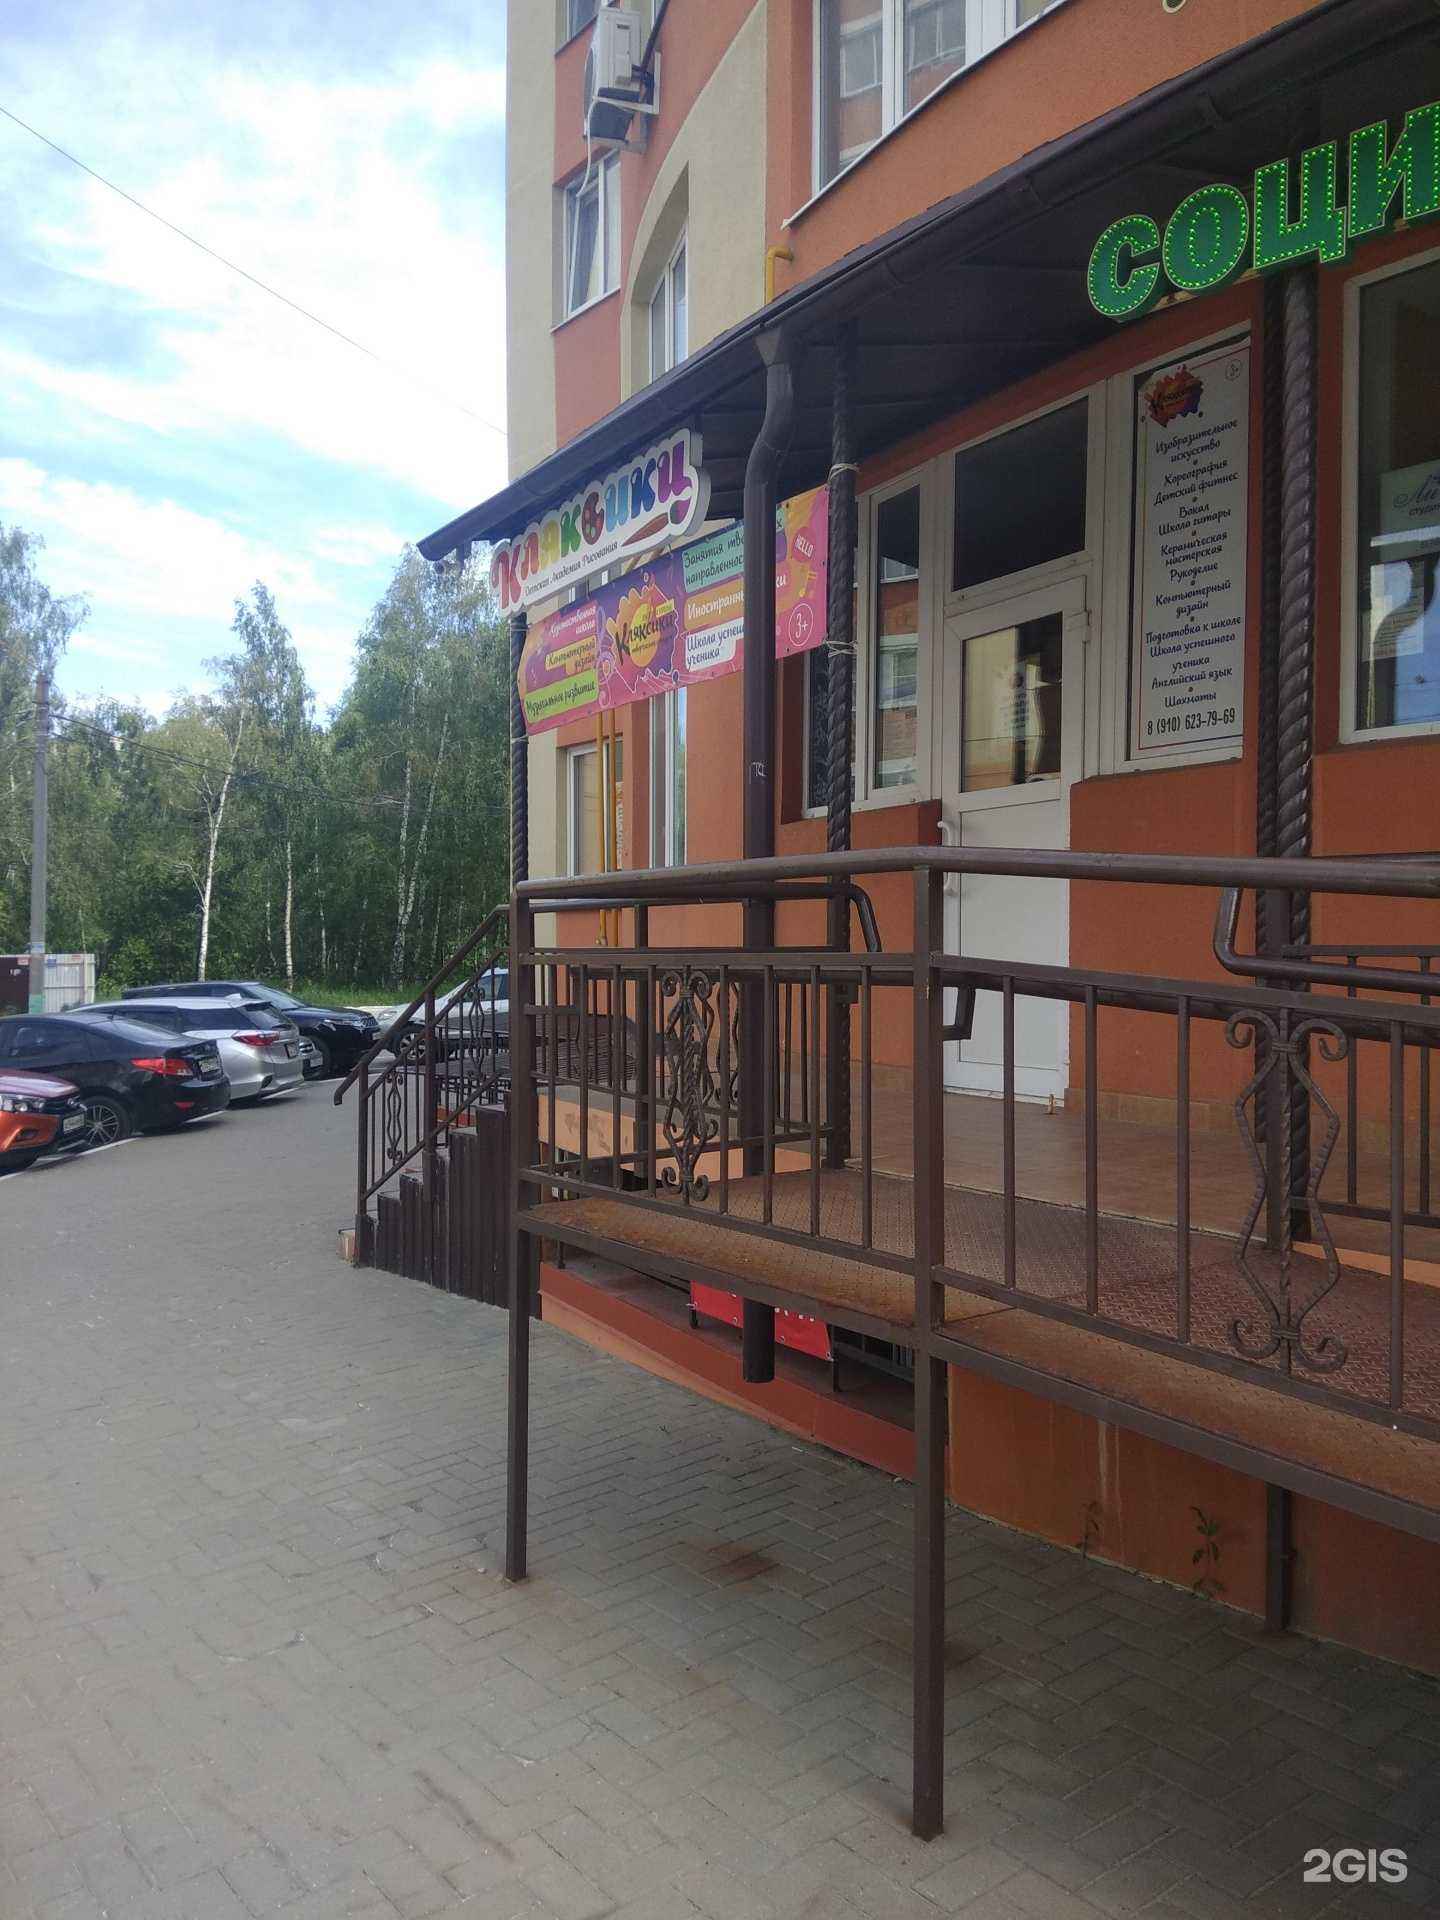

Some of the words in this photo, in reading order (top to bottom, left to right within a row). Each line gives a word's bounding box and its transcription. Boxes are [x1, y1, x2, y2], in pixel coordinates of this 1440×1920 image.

[1156, 419, 1238, 454] Изобразительное
[1170, 440, 1221, 463] искусство
[1164, 459, 1228, 487] Хореография
[1154, 482, 1197, 506] Детский
[1198, 472, 1239, 496] фитнес
[1158, 520, 1191, 536] Школа
[1192, 510, 1231, 531] гитары
[1179, 503, 1210, 519] Вокал
[684, 543, 724, 568] Занятия
[1160, 530, 1228, 557] Керамическая
[1166, 545, 1222, 567] мастерская
[1170, 562, 1218, 583] Рукоделие
[1155, 579, 1232, 607] Компьютерный
[1176, 601, 1208, 618] дизайн
[795, 612, 809, 639] 3+
[1146, 624, 1200, 646] Подготовка
[1211, 615, 1241, 631] школе
[687, 634, 716, 652] Школа
[1150, 642, 1182, 657] Школа
[1184, 633, 1235, 654] успешного
[687, 648, 720, 672] ученика
[1172, 656, 1210, 674] ученика
[1152, 670, 1206, 690] Английский
[1208, 667, 1233, 682] язык
[1164, 691, 1217, 708] Шахматы
[1147, 720, 1153, 736] 8
[1156, 716, 1181, 736] (910)
[1185, 708, 1235, 730] 623-79-69
